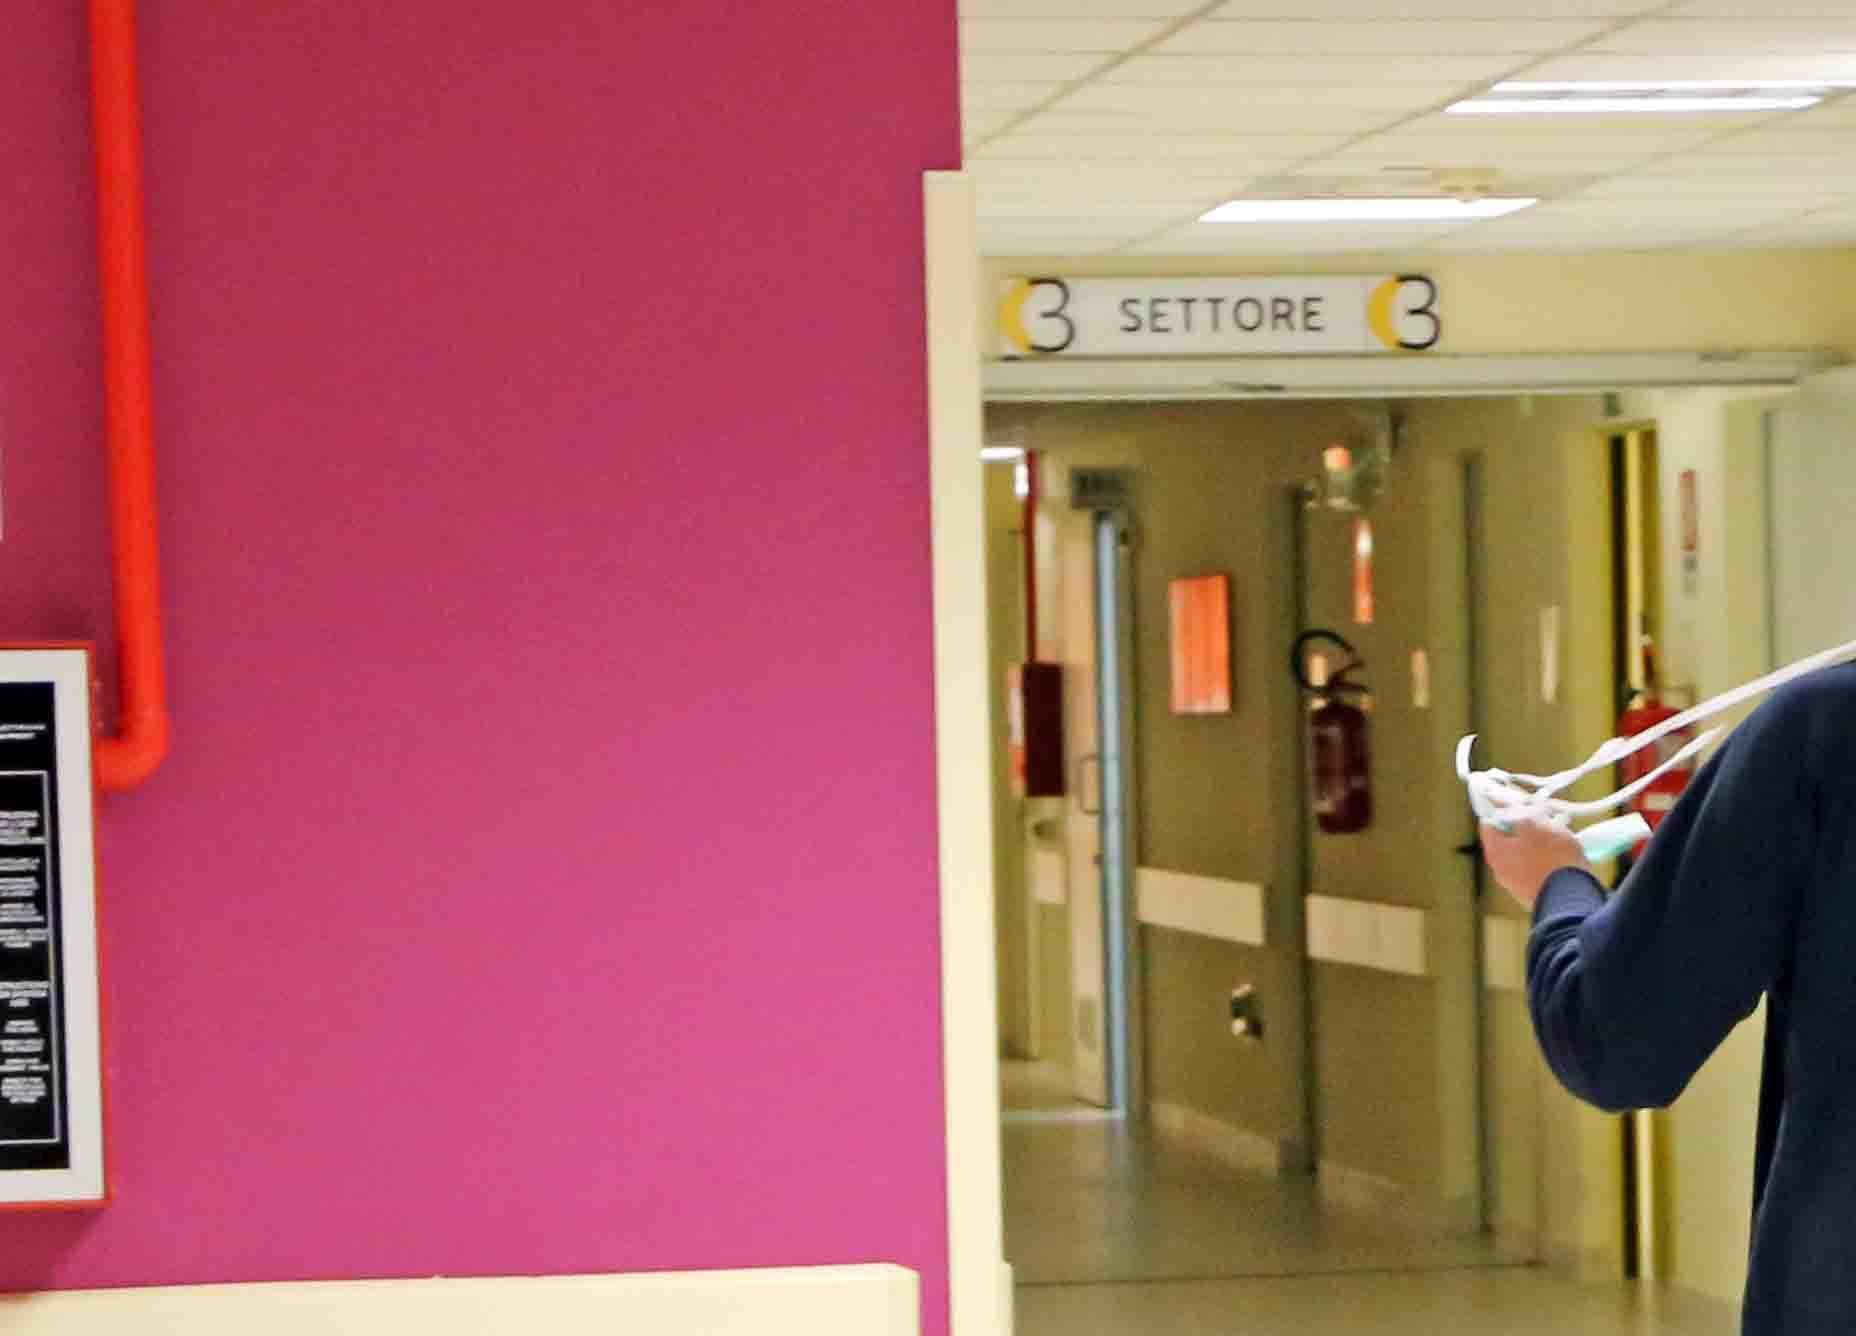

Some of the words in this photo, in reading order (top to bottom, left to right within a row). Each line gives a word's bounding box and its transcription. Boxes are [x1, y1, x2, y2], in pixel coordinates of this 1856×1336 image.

[1025, 276, 1076, 353] 3
[1119, 296, 1326, 334] SETTORE
[1393, 273, 1441, 351] 3
